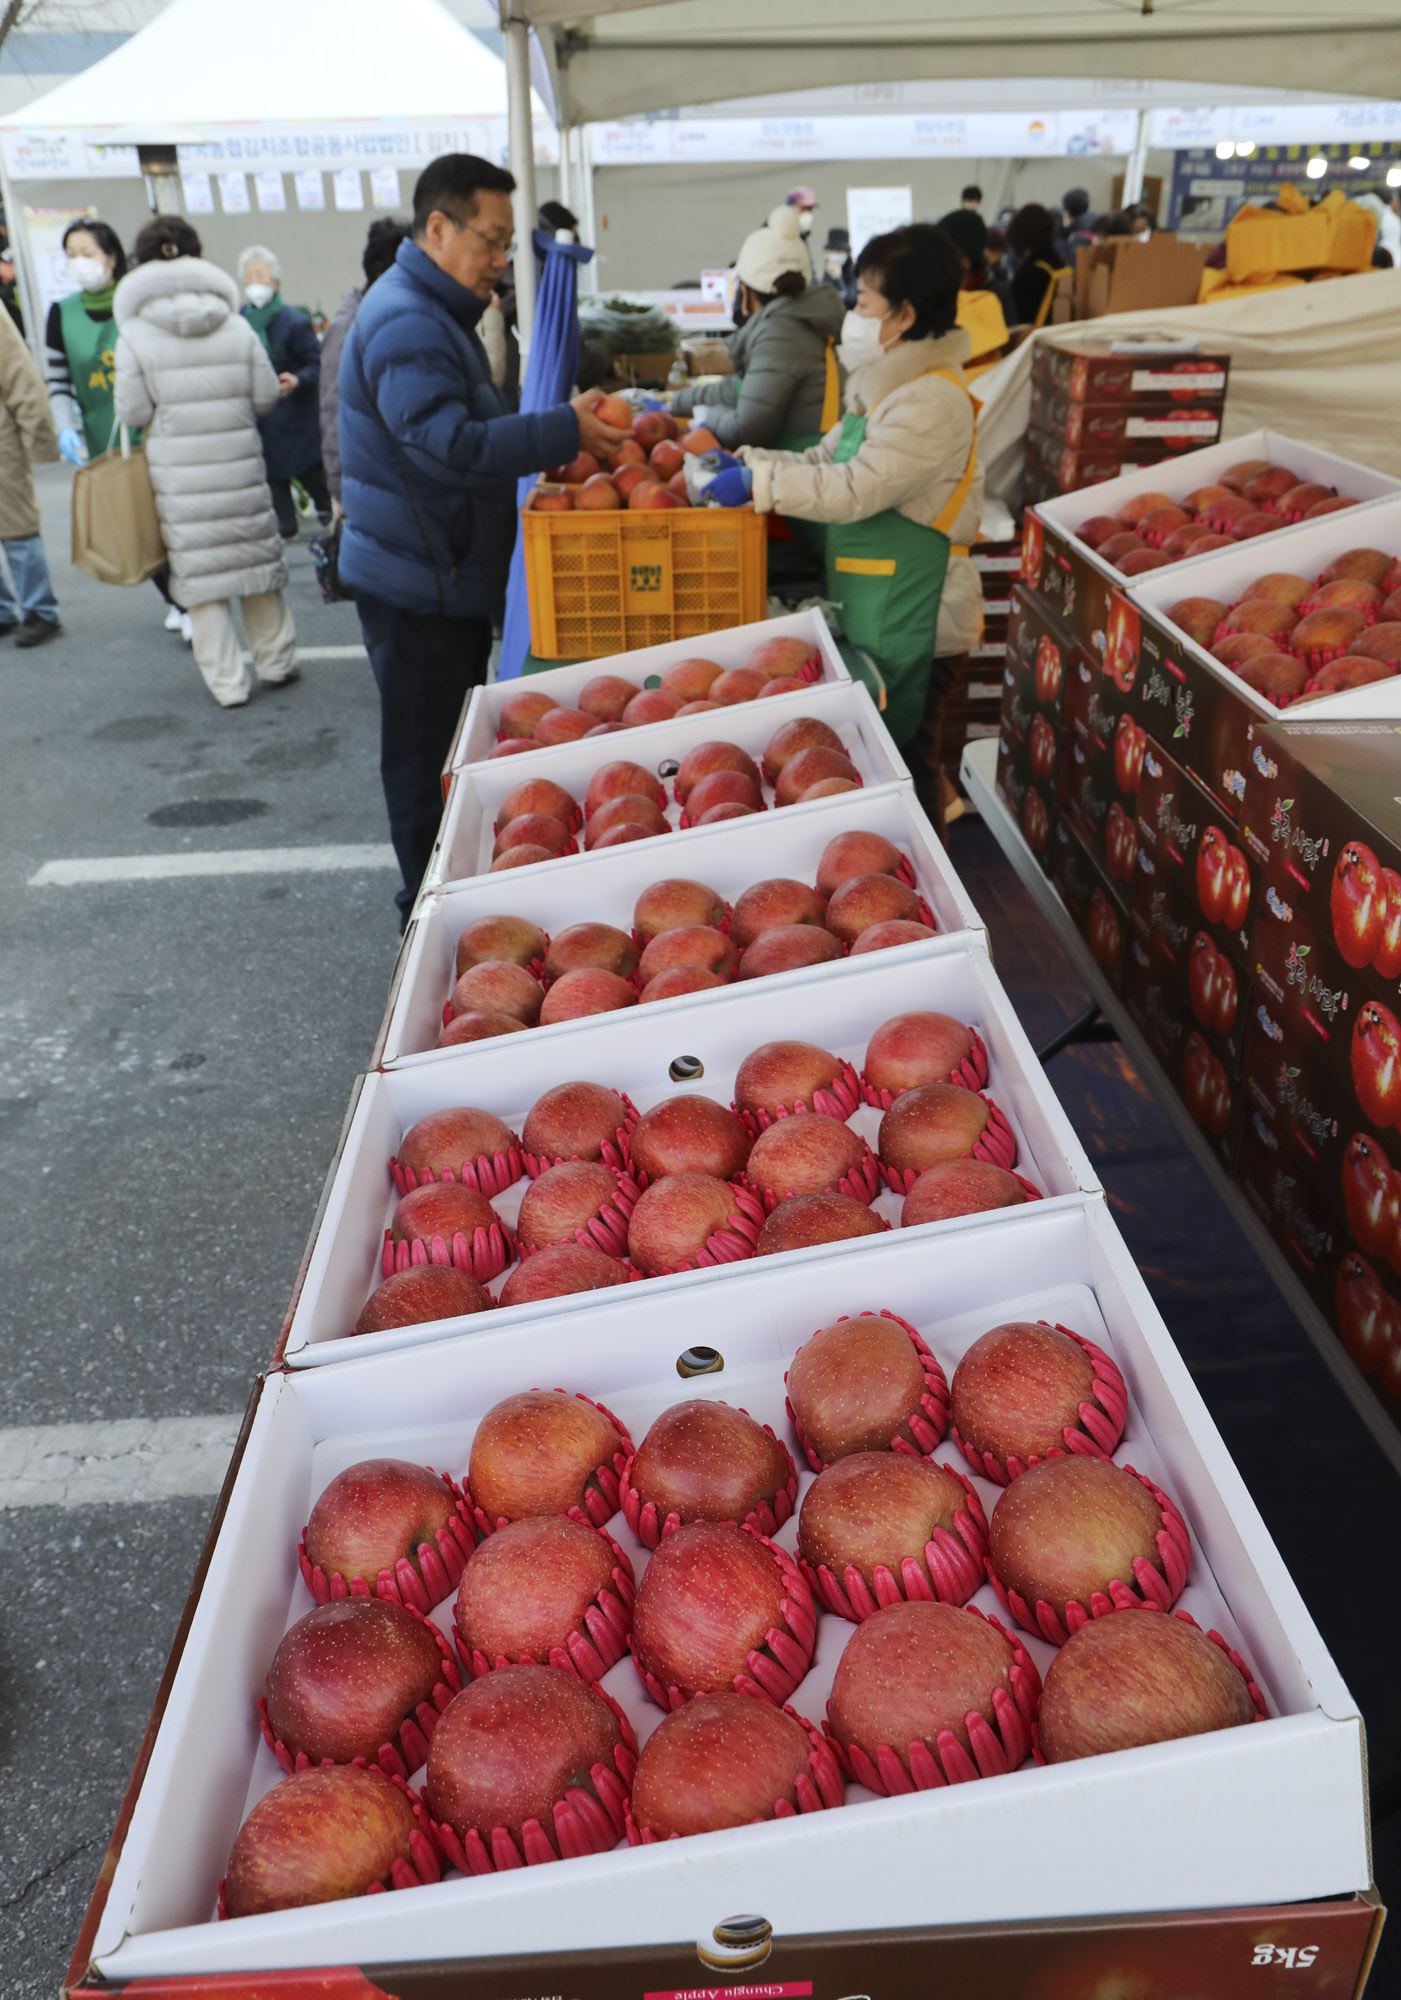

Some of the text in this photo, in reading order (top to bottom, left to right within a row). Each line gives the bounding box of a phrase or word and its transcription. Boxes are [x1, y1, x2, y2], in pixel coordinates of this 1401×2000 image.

[1270, 797, 1291, 849] 충주
[1292, 827, 1319, 871] 사과
[1285, 941, 1338, 1022] 충주 사과
[1251, 1943, 1320, 1969] 5kg
[674, 1984, 783, 2000] Chungju Apple
